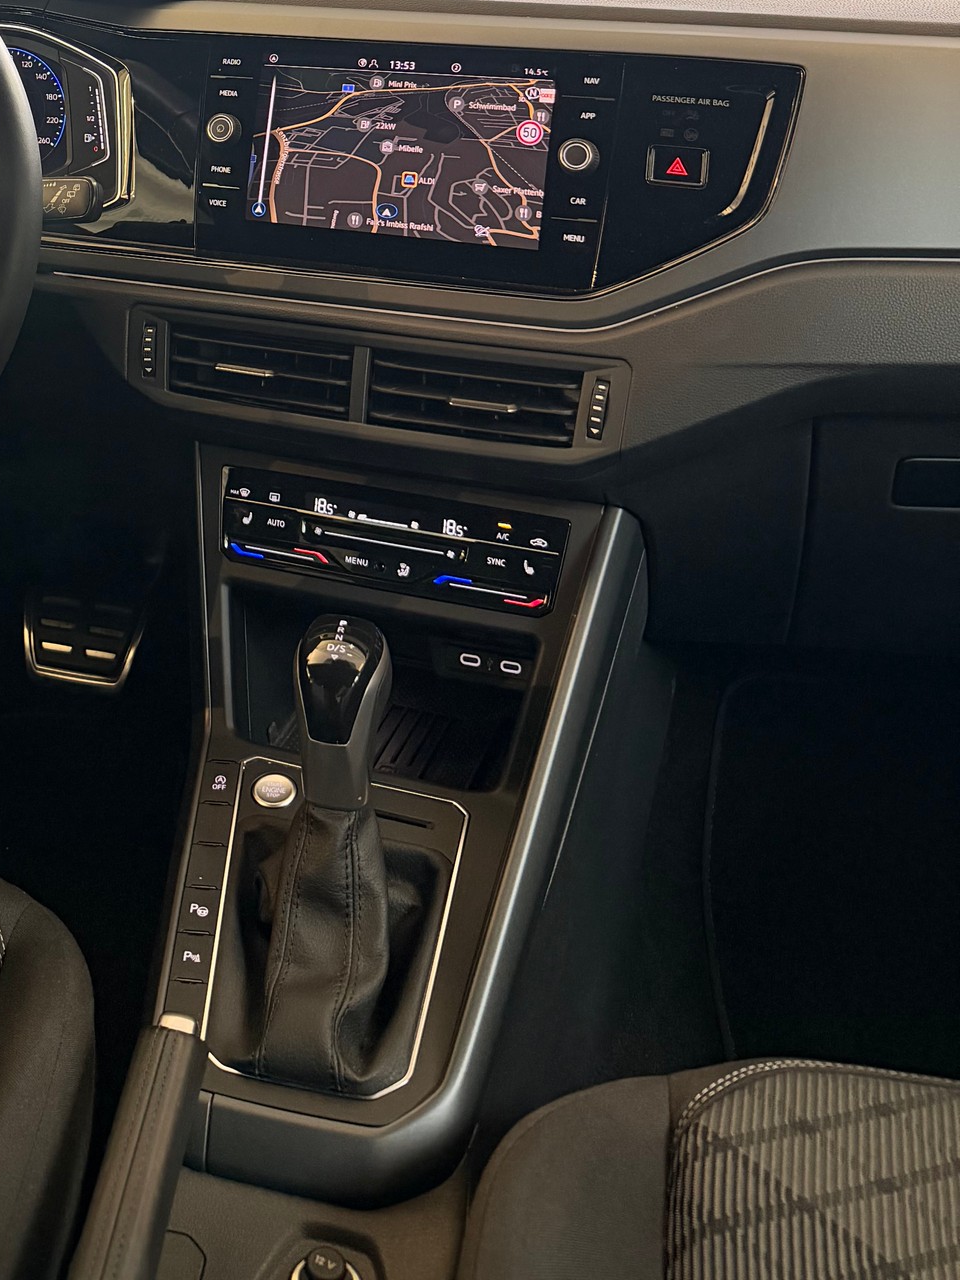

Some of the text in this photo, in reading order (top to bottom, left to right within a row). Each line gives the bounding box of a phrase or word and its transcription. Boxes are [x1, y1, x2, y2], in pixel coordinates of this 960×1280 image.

[222, 58, 242, 66] RADIO
[389, 60, 416, 71] 13:53
[584, 77, 600, 85] NAV
[46, 93, 58, 101] 180
[219, 89, 238, 97] MEDIA
[529, 89, 537, 97] N
[652, 94, 730, 108] PASSENGER AIR BAG
[468, 101, 517, 112] Schwimmbad
[580, 112, 596, 120] APP
[375, 122, 396, 131] 22kW
[522, 127, 538, 139] 50
[37, 137, 51, 145] 260
[210, 165, 231, 174] PHONE
[418, 177, 435, 185] ALDI
[208, 199, 227, 207] VOICE
[570, 197, 586, 206] CAR
[563, 234, 585, 243] MENU
[267, 518, 286, 528] AUTO
[496, 532, 510, 541] A/C
[344, 555, 369, 568] MENU
[487, 556, 506, 567] SYNC
[326, 643, 346, 653] D/S
[261, 786, 286, 794] ENGINE
[190, 903, 199, 913] P
[183, 950, 192, 961] P
